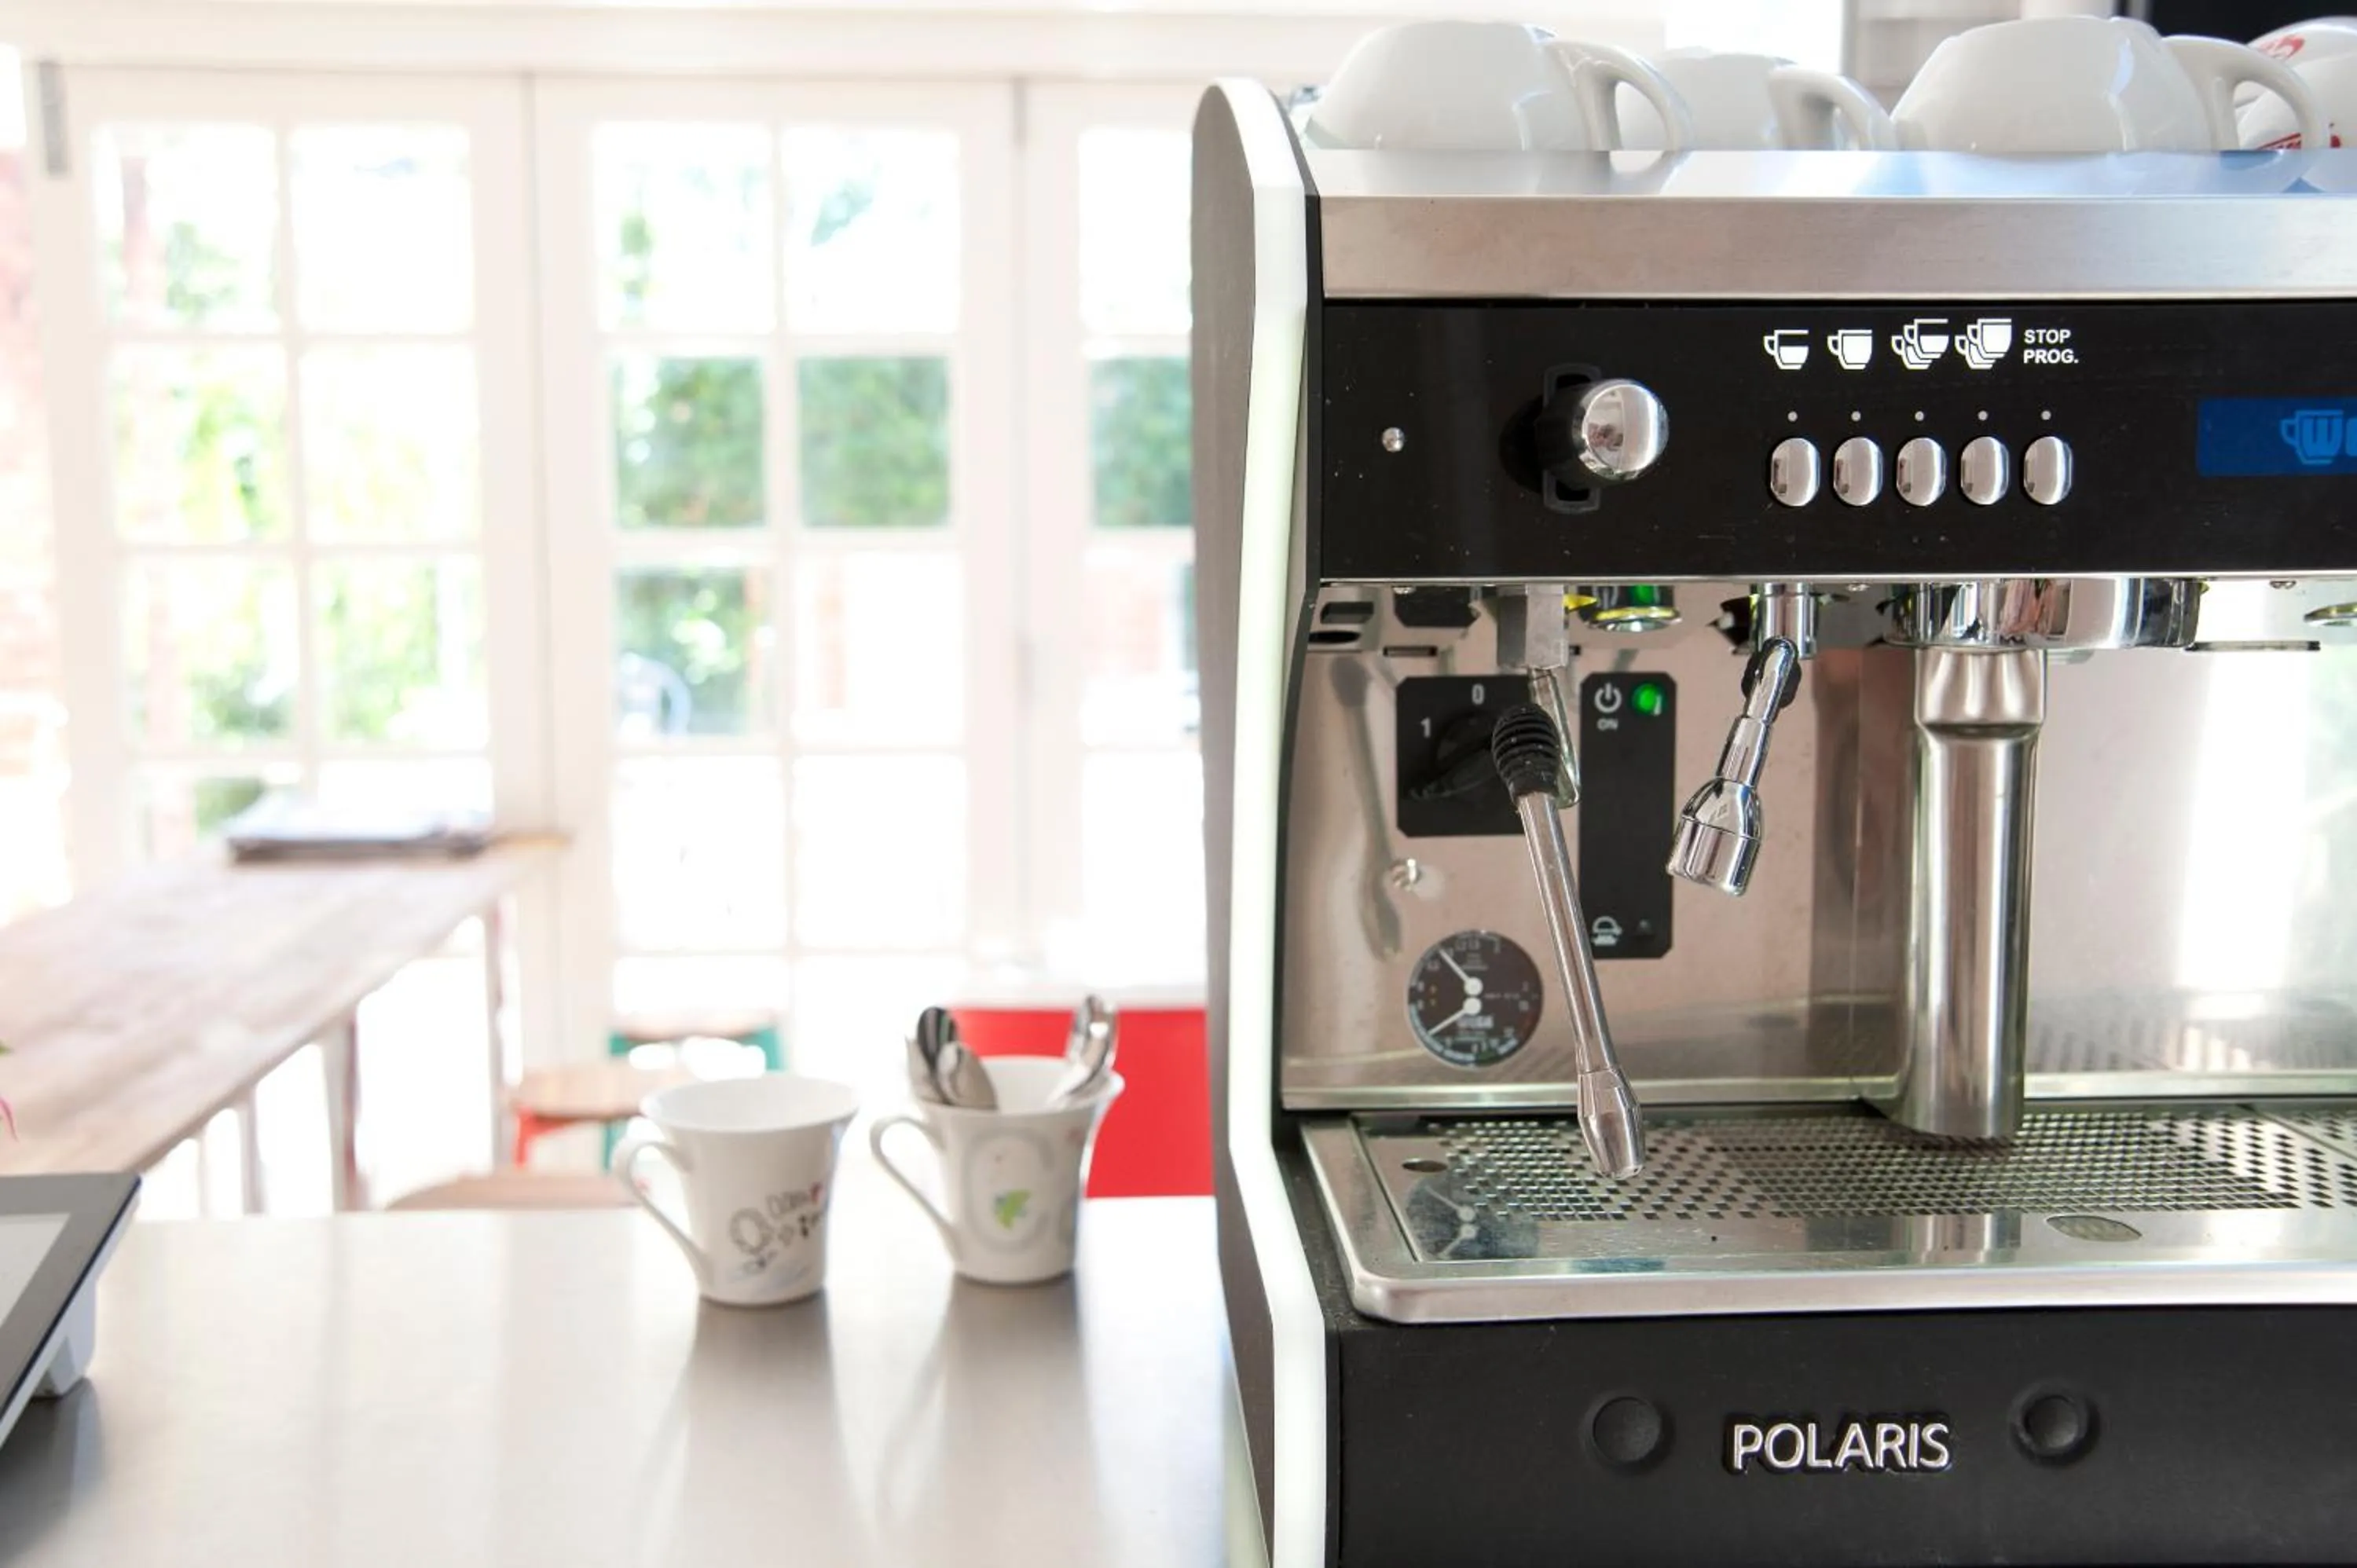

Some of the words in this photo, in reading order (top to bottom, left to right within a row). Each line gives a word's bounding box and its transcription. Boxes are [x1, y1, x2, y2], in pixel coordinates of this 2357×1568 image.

[2024, 328, 2072, 344] STOP
[2023, 348, 2079, 364] PROG.
[1420, 717, 1431, 738] 1
[1596, 718, 1618, 731] ON
[1733, 1423, 1949, 1470] POLARIS
